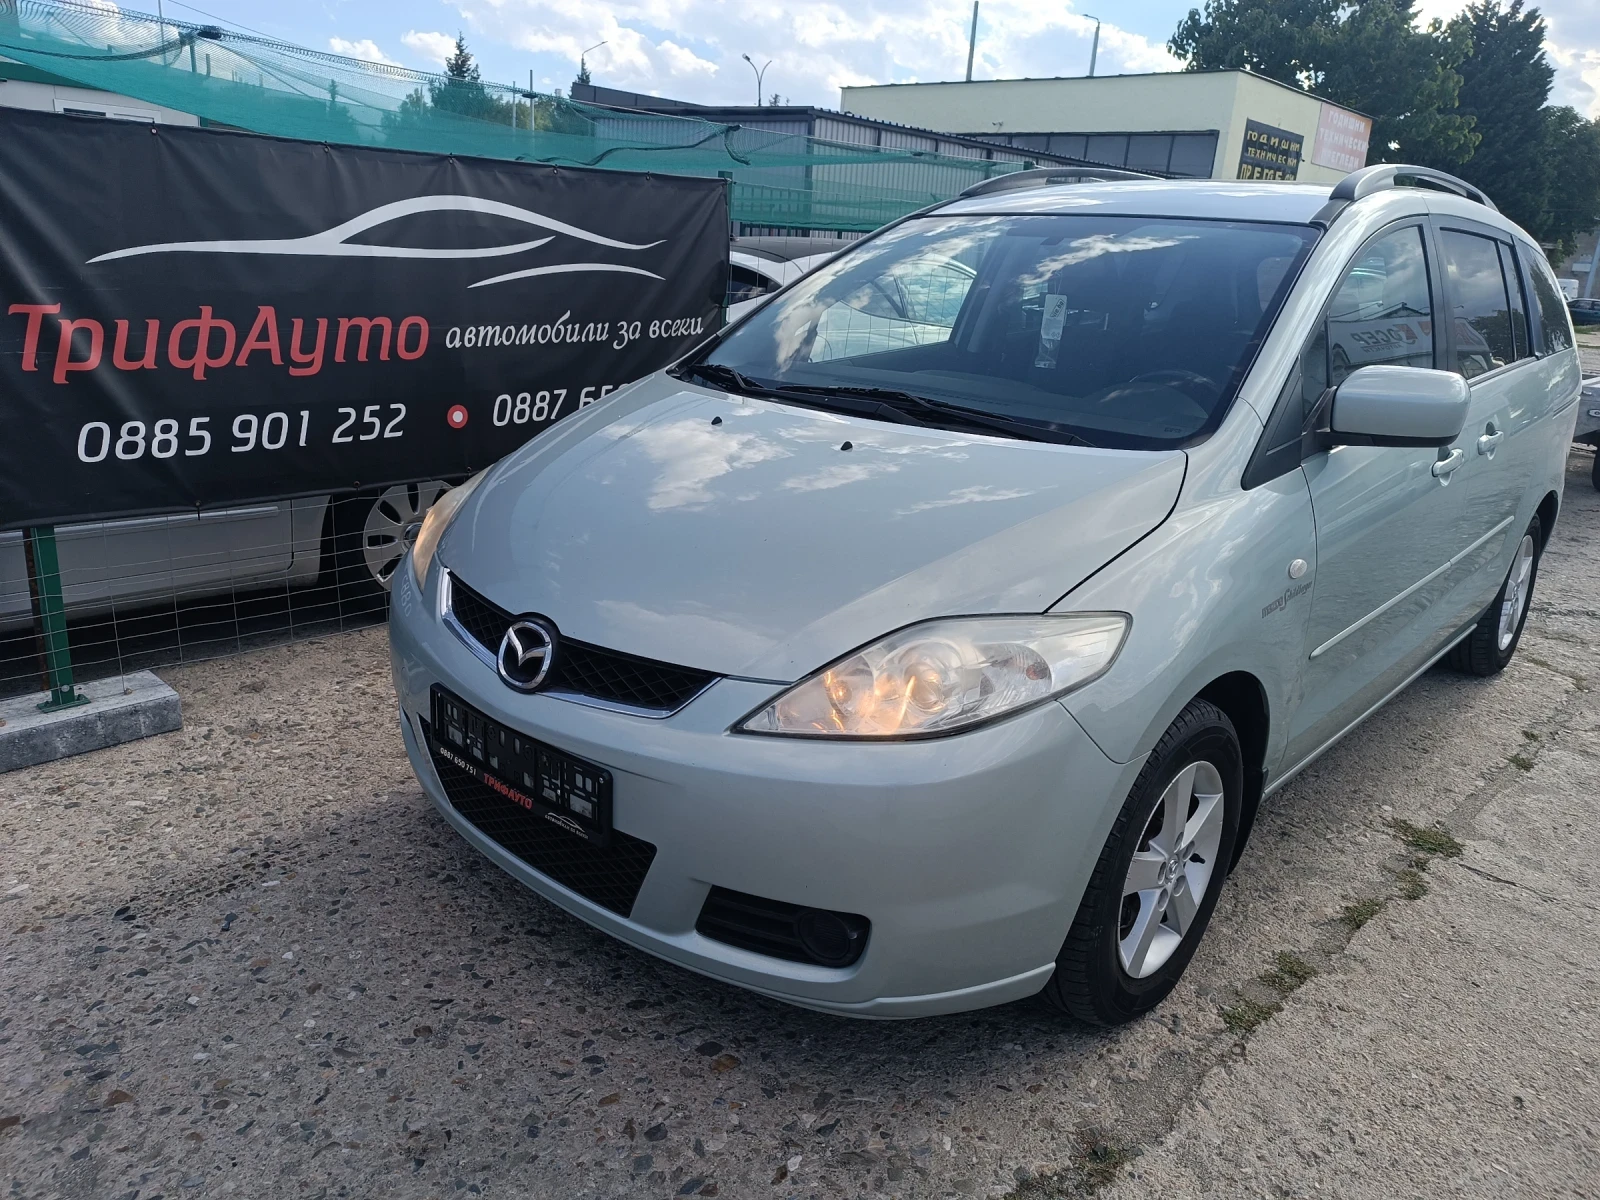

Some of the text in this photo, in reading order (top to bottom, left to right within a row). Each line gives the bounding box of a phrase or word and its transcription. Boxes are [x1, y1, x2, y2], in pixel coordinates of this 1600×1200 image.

[1328, 110, 1365, 133] ГОДИШНИ
[1247, 130, 1300, 152] ГОДИШНИ
[1319, 127, 1368, 152] ТЕХНИЧЕСКИ
[1247, 147, 1298, 167] ТЕХНИЧЕСКИ
[7, 303, 430, 384] ТрифАуто
[445, 310, 704, 350] автомобили за всеки
[492, 389, 567, 427] 0887
[77, 403, 407, 463] 0885 901 252
[440, 747, 476, 775] 0887 650 751
[483, 772, 533, 810] ТРИФАУТО
